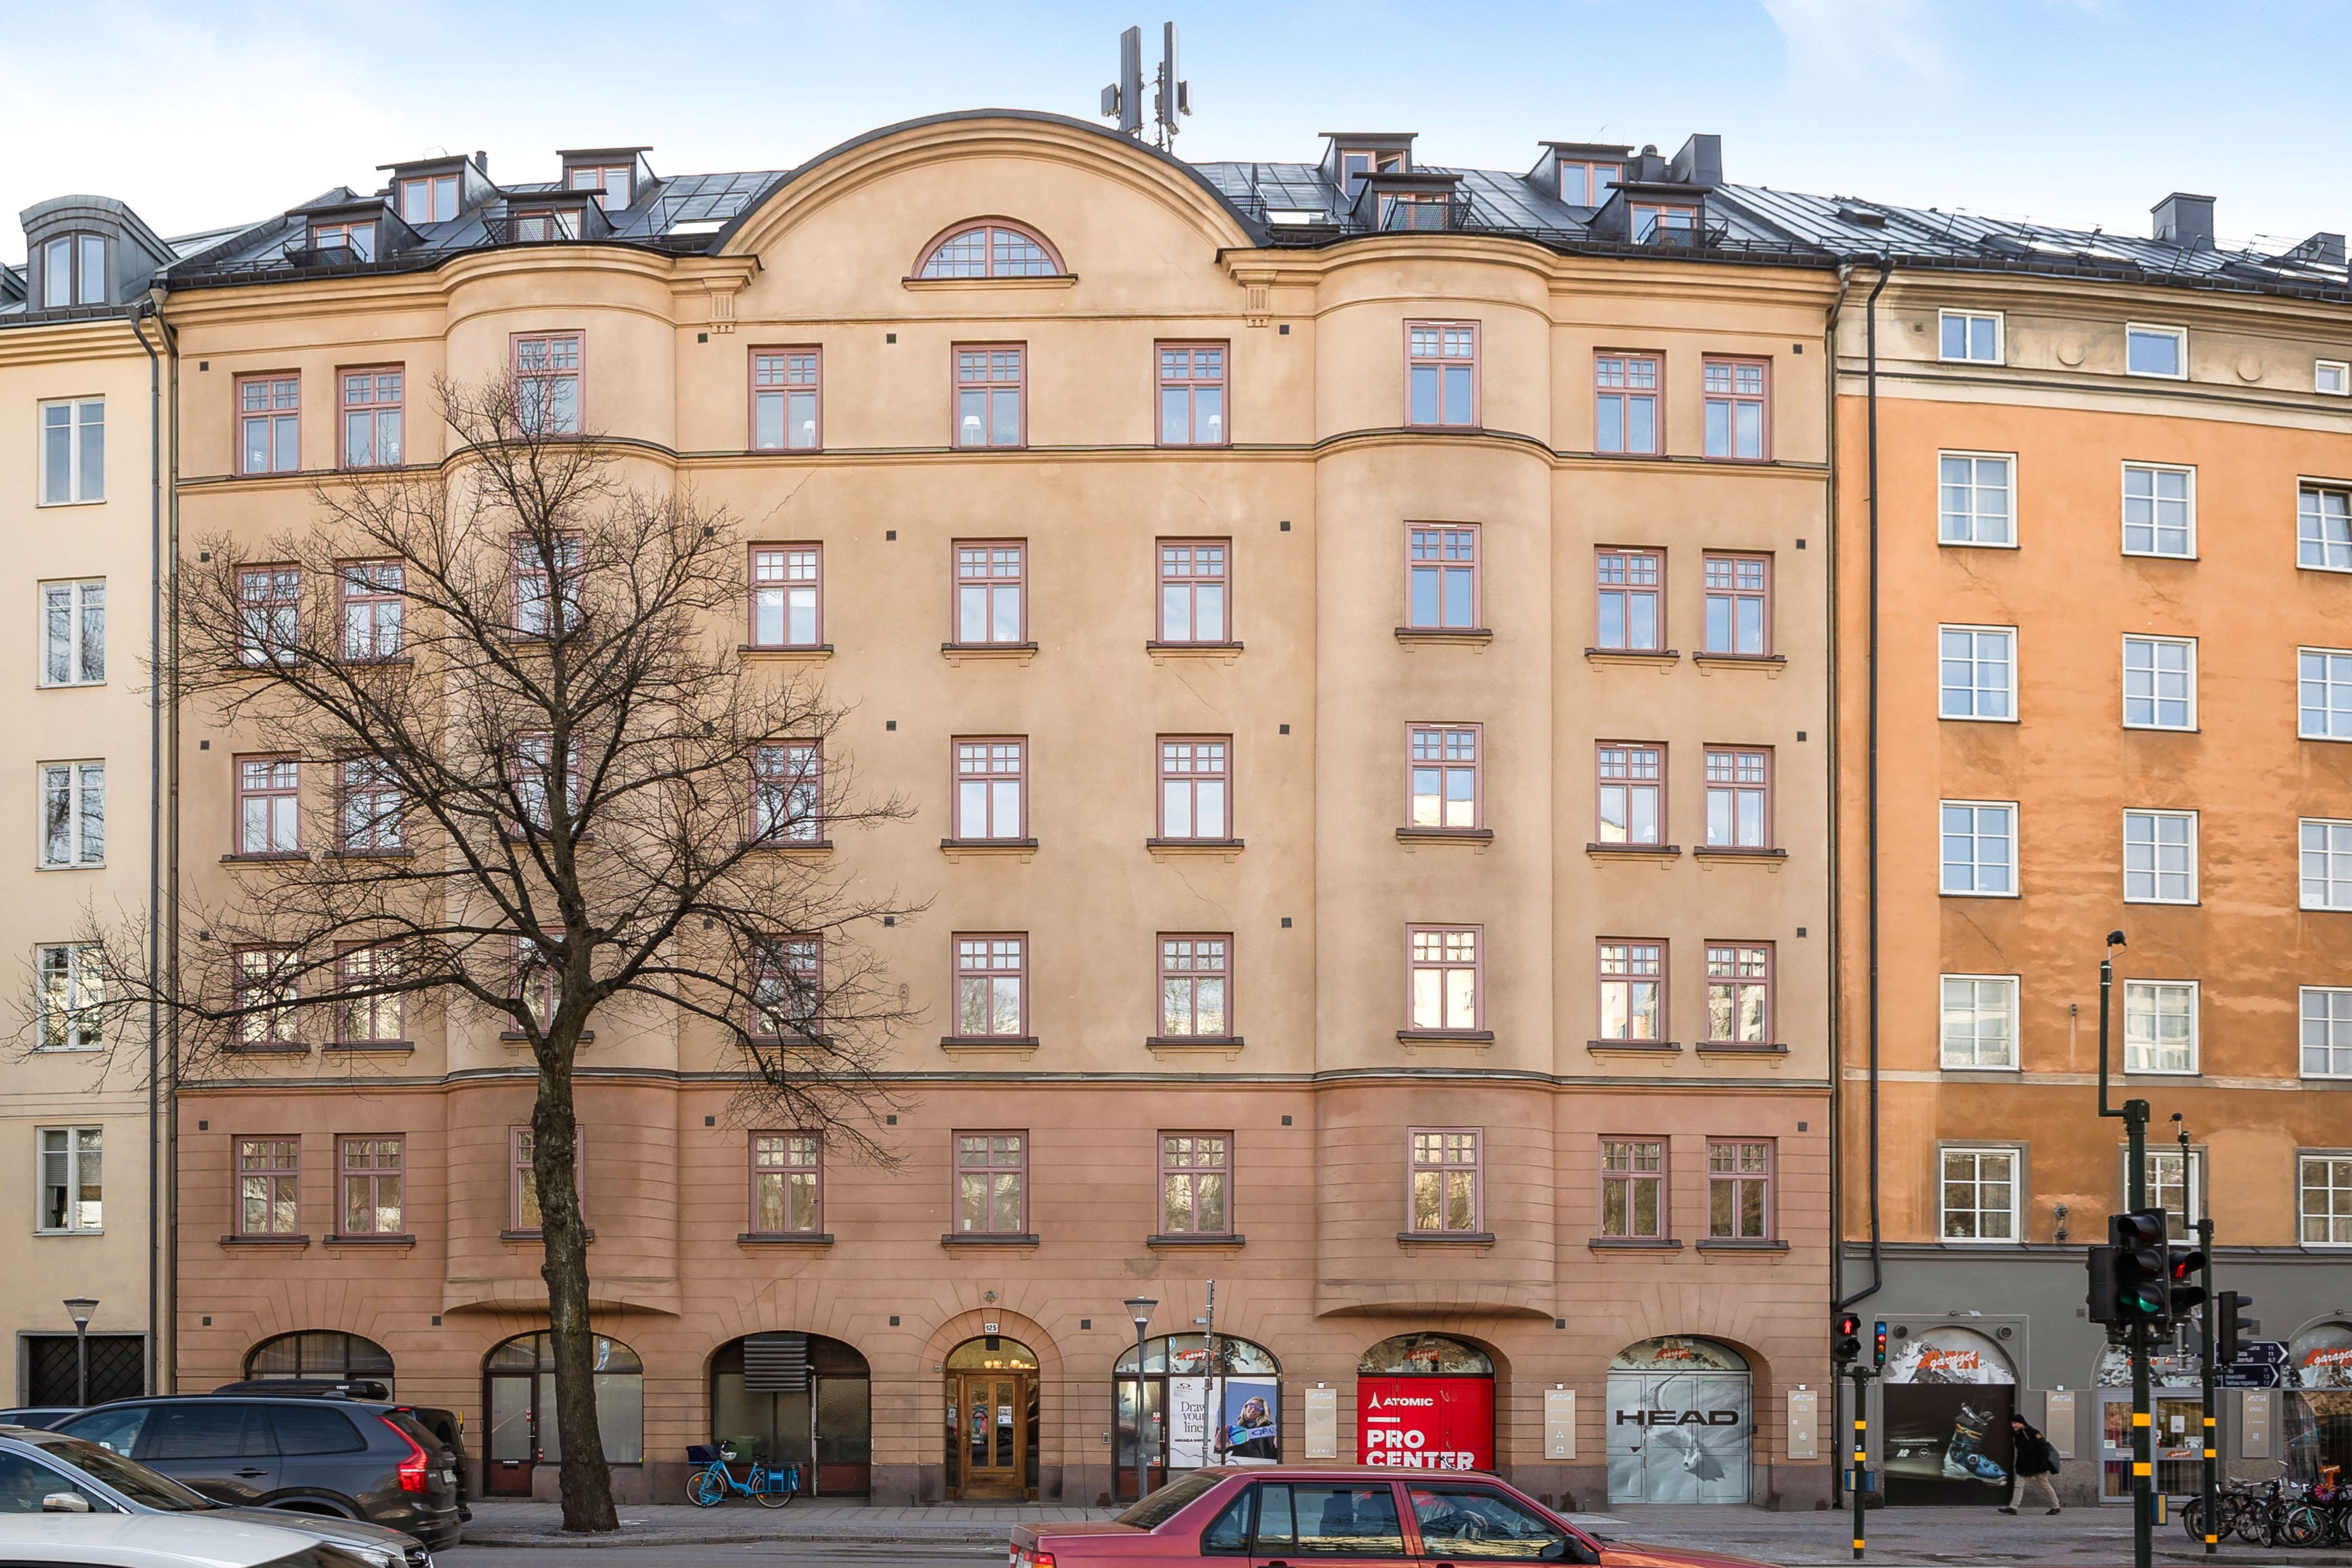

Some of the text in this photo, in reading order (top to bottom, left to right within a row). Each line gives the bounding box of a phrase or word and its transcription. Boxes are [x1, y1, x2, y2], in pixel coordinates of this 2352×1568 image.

[1930, 1351, 1976, 1372] garaget
[1383, 1397, 1434, 1407] ATOMIC
[1616, 1410, 1739, 1426] HEAD
[1184, 1421, 1203, 1432] line
[1367, 1429, 1425, 1448] PRO
[1366, 1451, 1474, 1470] CENTER
[1896, 1449, 1910, 1458] K2
